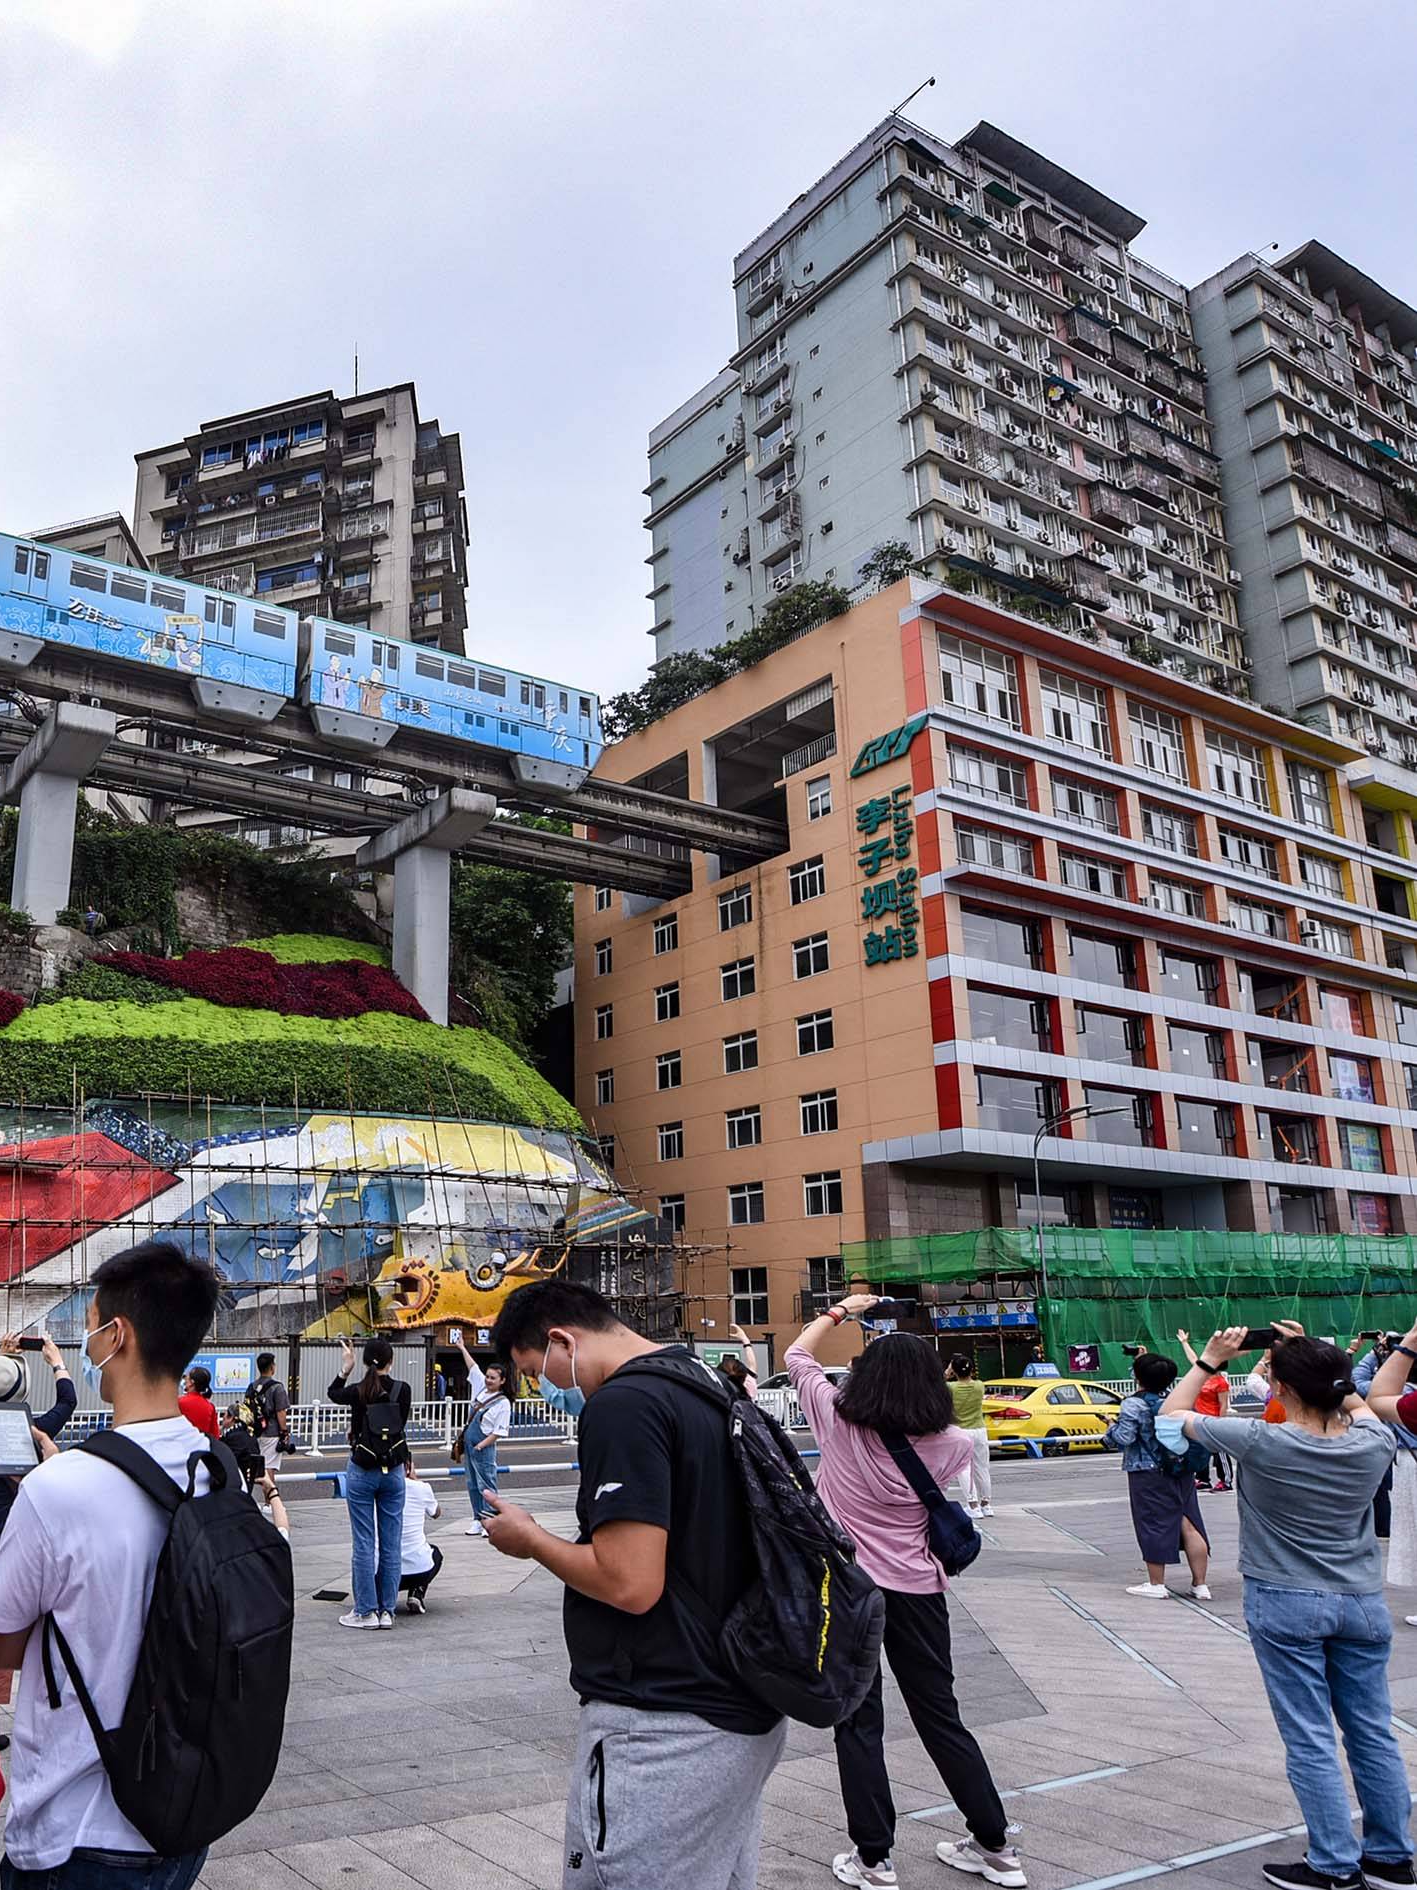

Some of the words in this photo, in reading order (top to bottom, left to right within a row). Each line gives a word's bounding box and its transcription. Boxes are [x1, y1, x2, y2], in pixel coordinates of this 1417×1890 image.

[891, 784, 914, 861] Liziba
[855, 795, 903, 967] 李子坝站
[897, 867, 920, 959] Station
